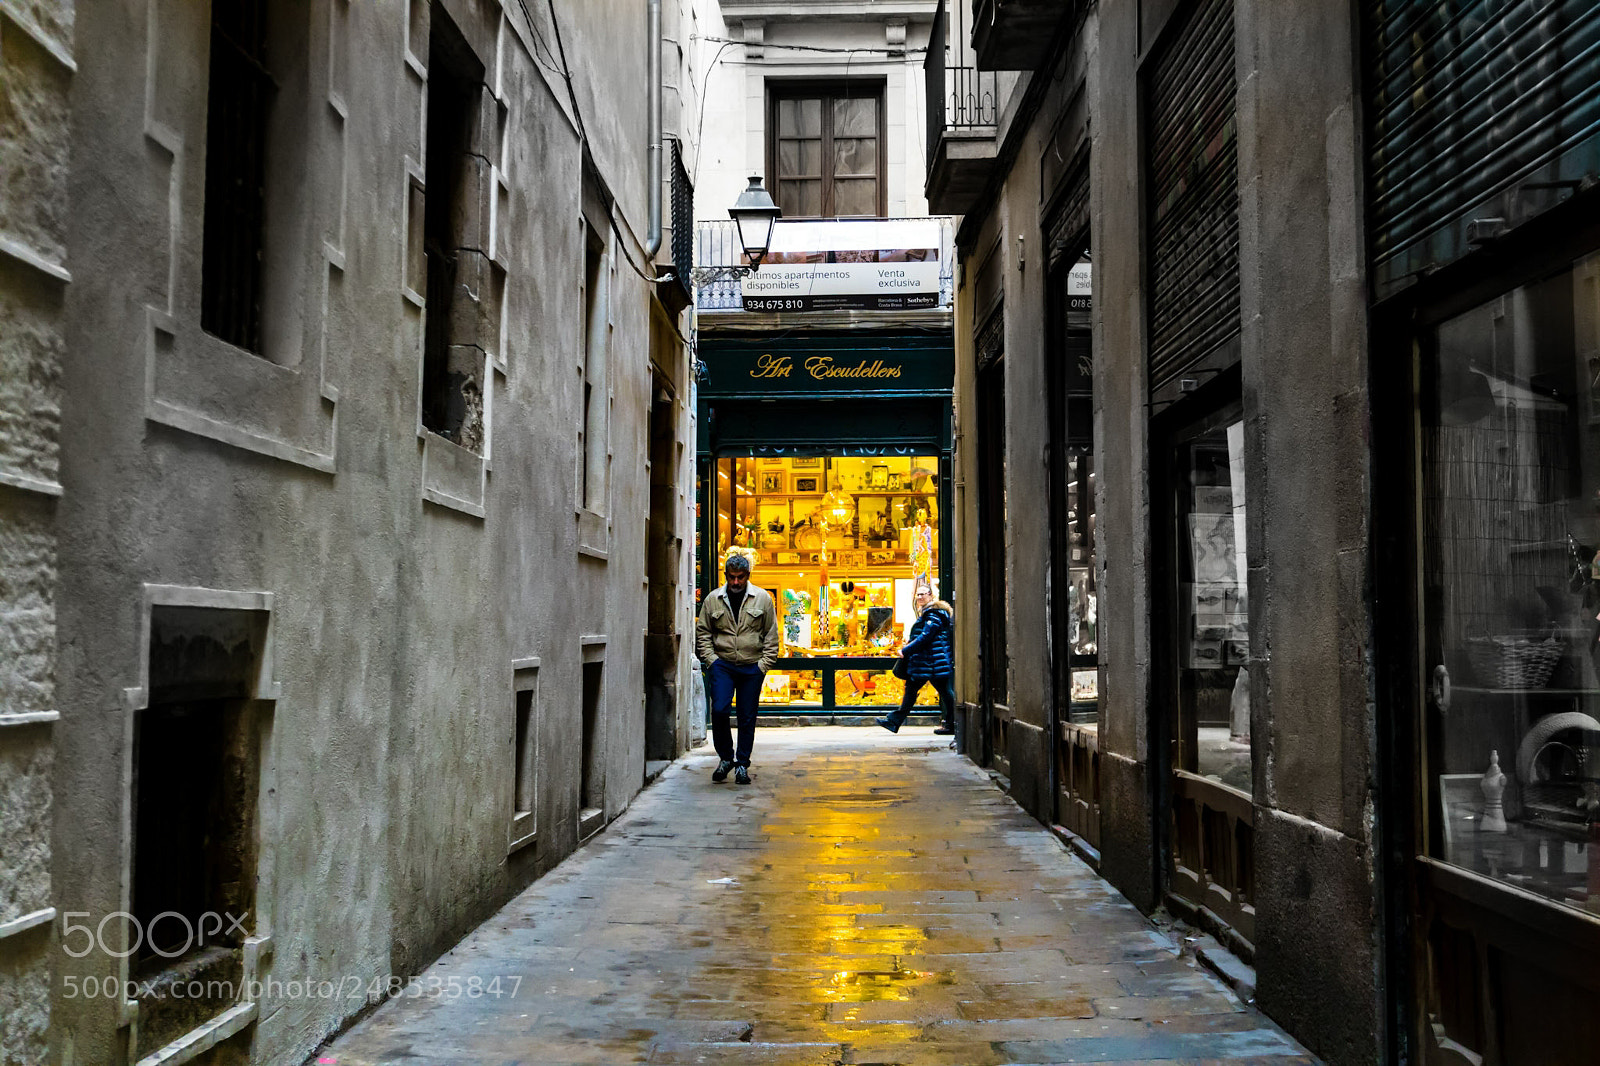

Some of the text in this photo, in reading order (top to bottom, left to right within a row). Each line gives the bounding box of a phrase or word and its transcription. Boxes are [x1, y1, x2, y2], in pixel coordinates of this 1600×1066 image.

[784, 271, 851, 281] apartamentos
[878, 269, 905, 278] Venta
[746, 281, 800, 291] disponibles
[878, 279, 921, 288] exclusiva
[747, 300, 764, 309] 934
[766, 300, 784, 309] 675
[785, 299, 803, 309] 810
[750, 354, 902, 380] Art Escudellers
